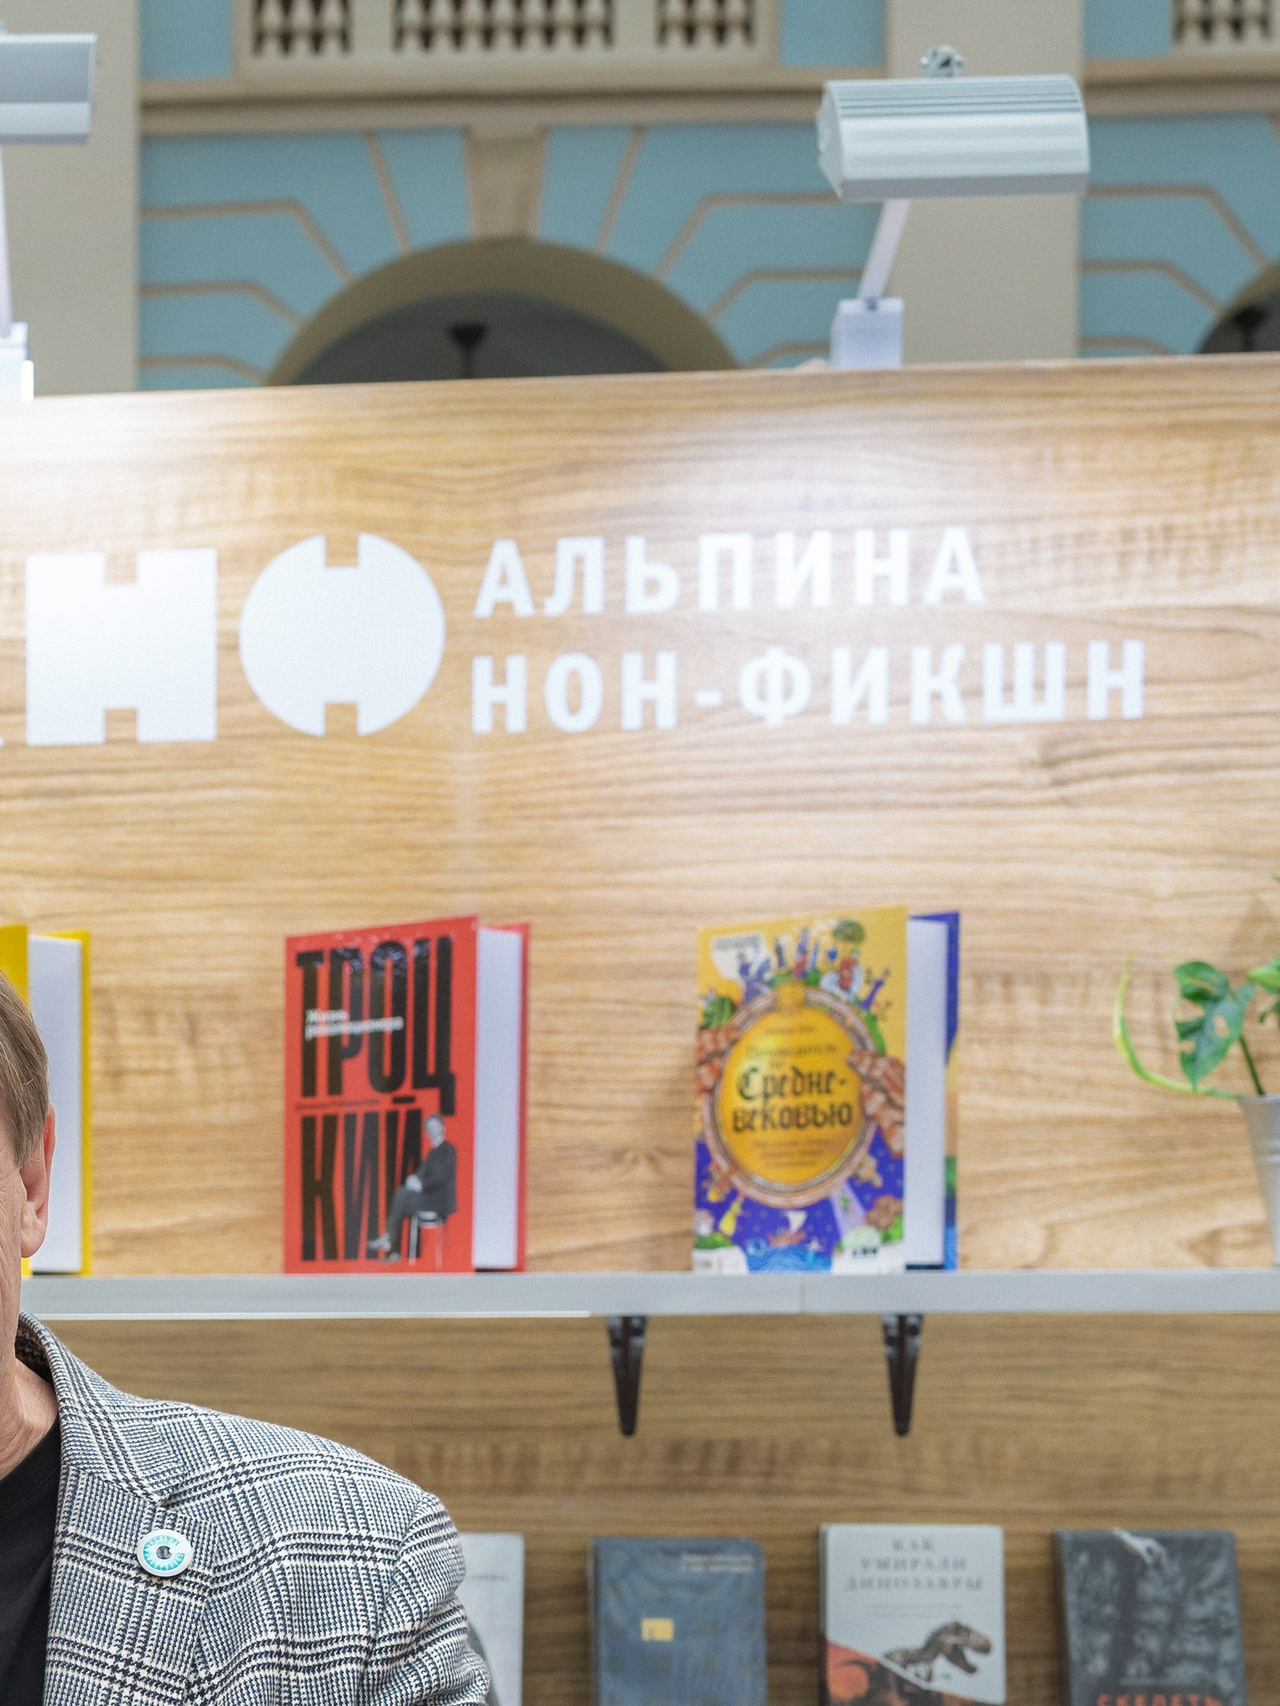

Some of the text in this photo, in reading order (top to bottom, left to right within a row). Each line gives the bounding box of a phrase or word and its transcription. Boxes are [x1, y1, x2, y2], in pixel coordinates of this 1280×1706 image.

[471, 528, 985, 620] АЛЬПИНА
[470, 637, 1146, 735] НОН-ФИКШН
[296, 935, 457, 1116] ТРОЦ
[732, 1101, 853, 1133] вековью
[737, 1066, 848, 1106] Средне-
[301, 1096, 424, 1265] КИЙ
